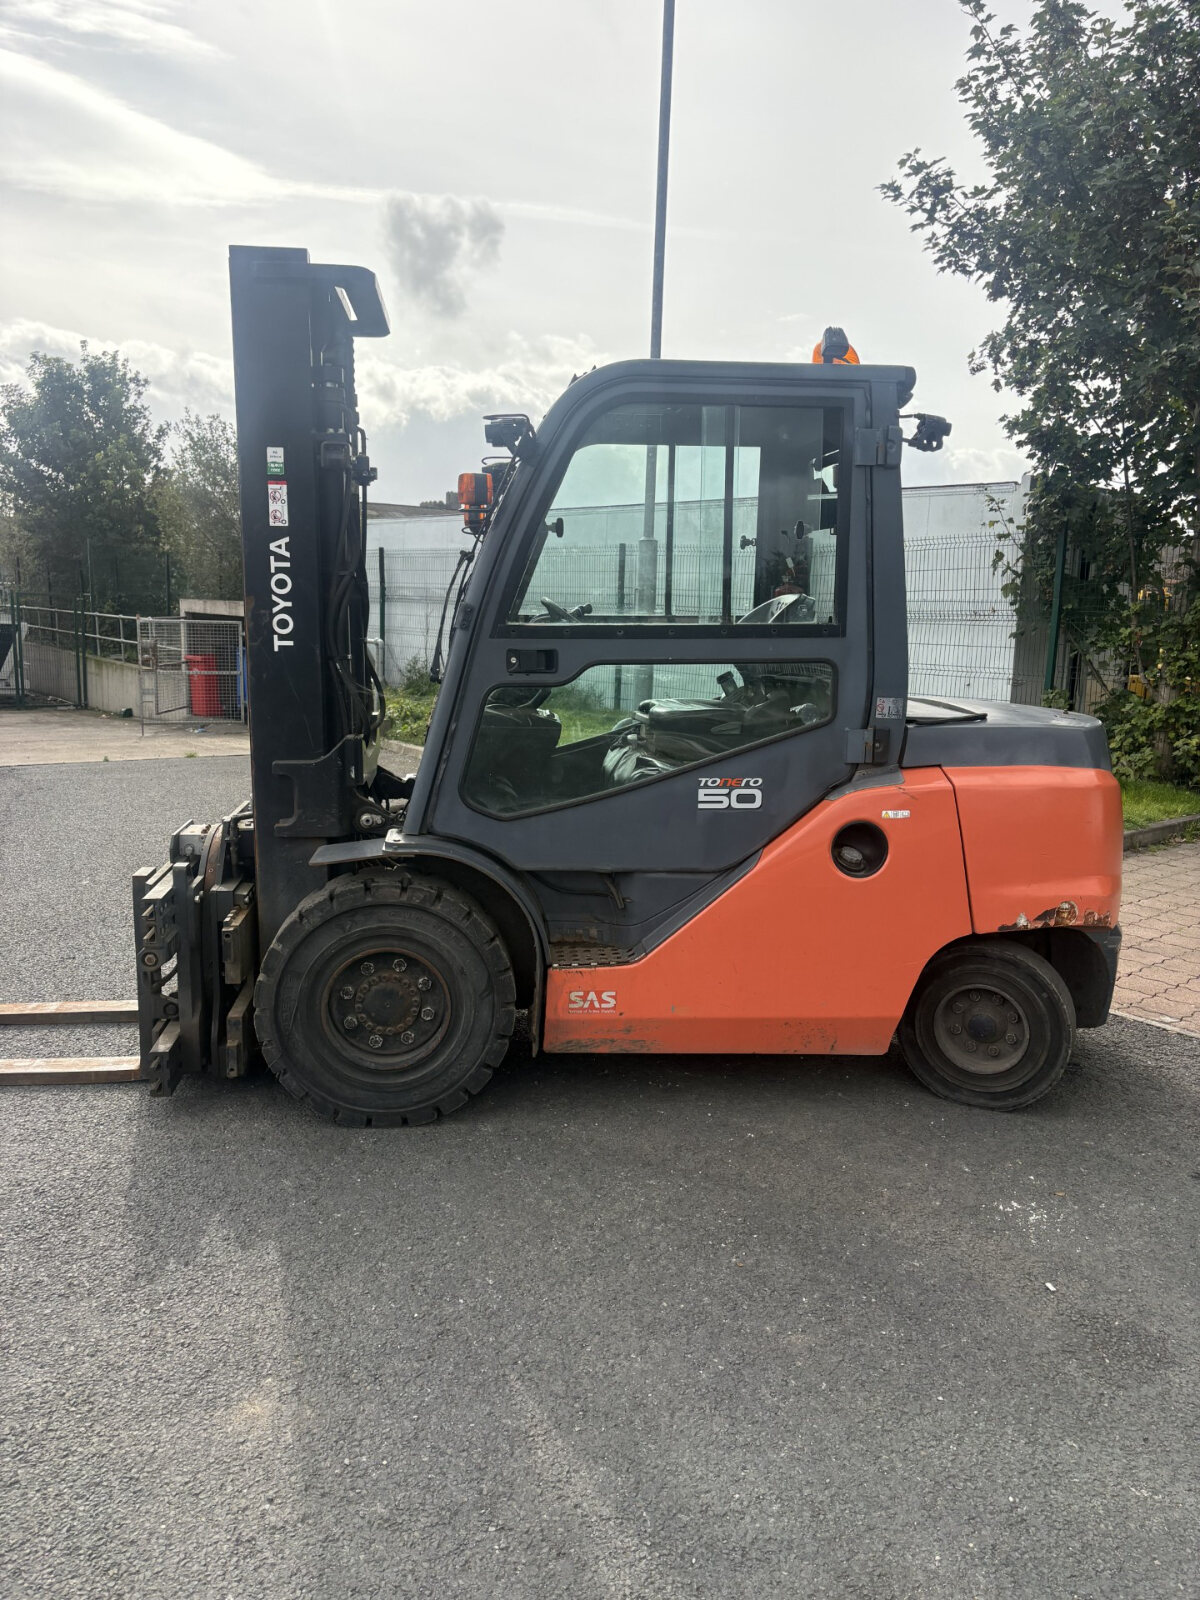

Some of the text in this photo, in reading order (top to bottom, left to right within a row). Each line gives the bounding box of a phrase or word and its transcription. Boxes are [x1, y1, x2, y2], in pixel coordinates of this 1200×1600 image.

[269, 536, 294, 652] TOYOTA
[697, 788, 763, 809] 50
[568, 991, 617, 1009] SAS
